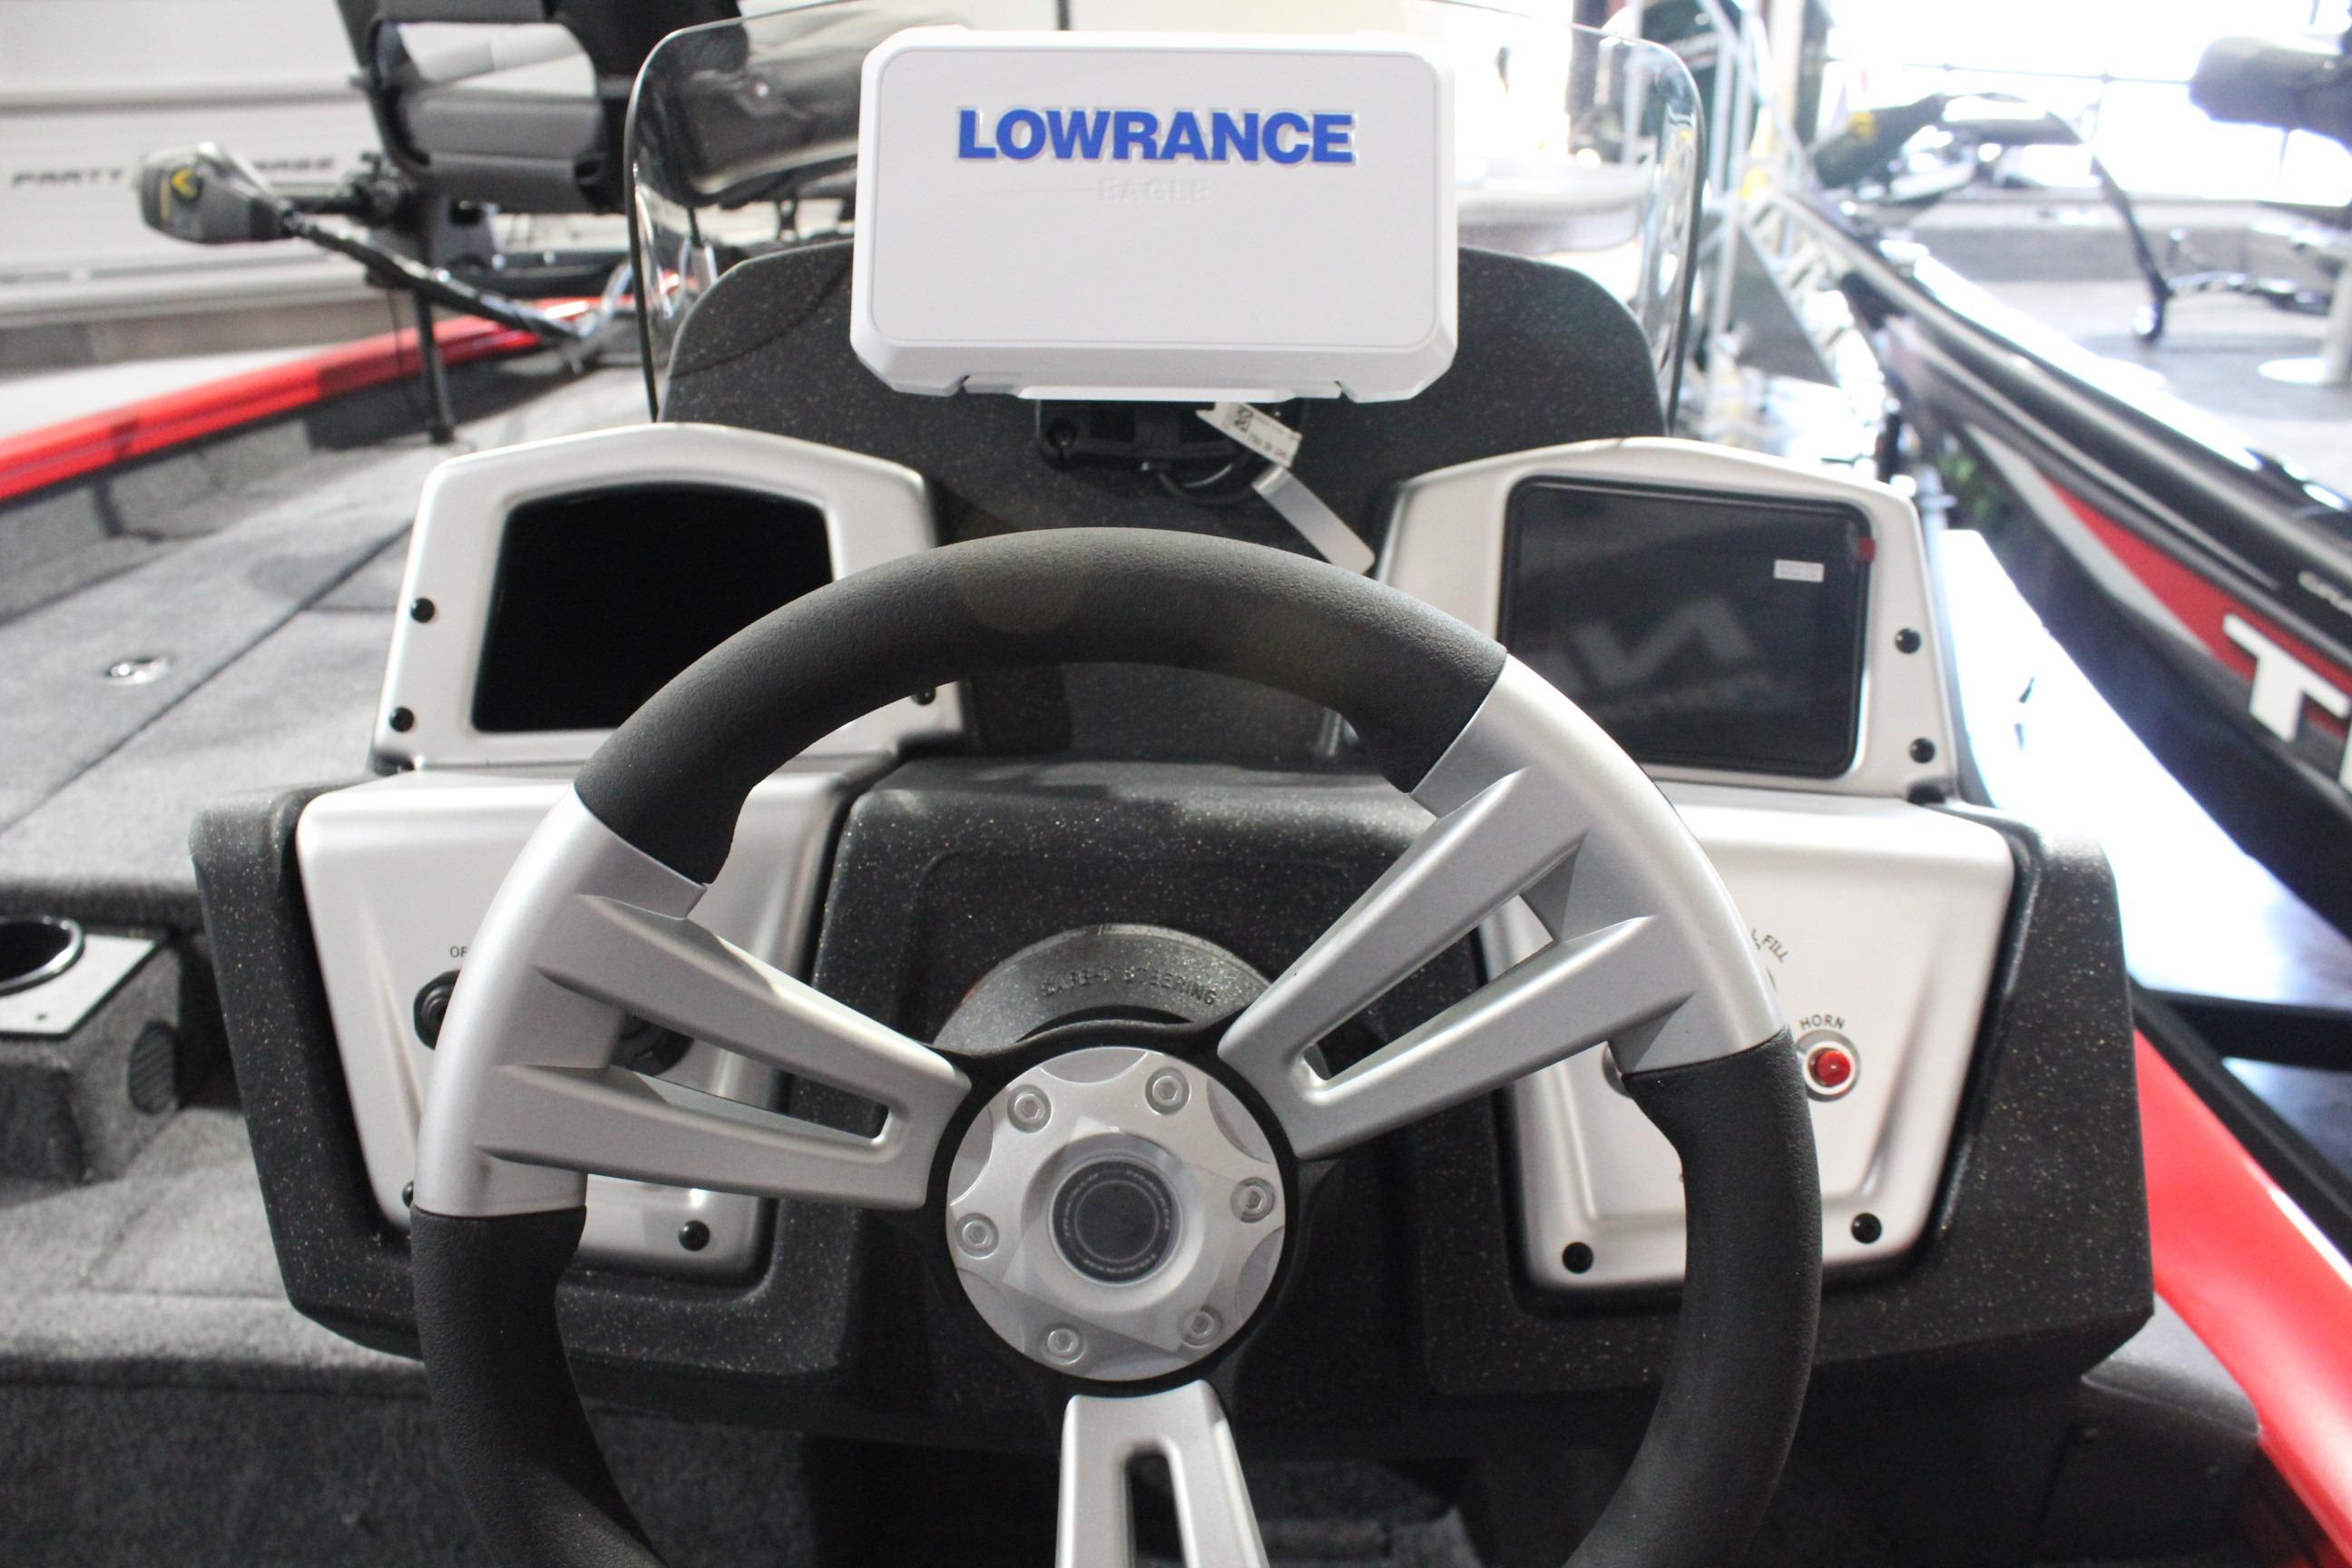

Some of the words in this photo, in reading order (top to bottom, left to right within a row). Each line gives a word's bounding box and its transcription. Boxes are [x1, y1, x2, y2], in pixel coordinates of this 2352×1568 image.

[957, 108, 1354, 164] LOWRANCE
[1098, 179, 1210, 202] EAGLE
[1762, 934, 1788, 964] FILL
[1123, 965, 1217, 1005] STEERING
[1799, 1014, 1845, 1030] HORN
